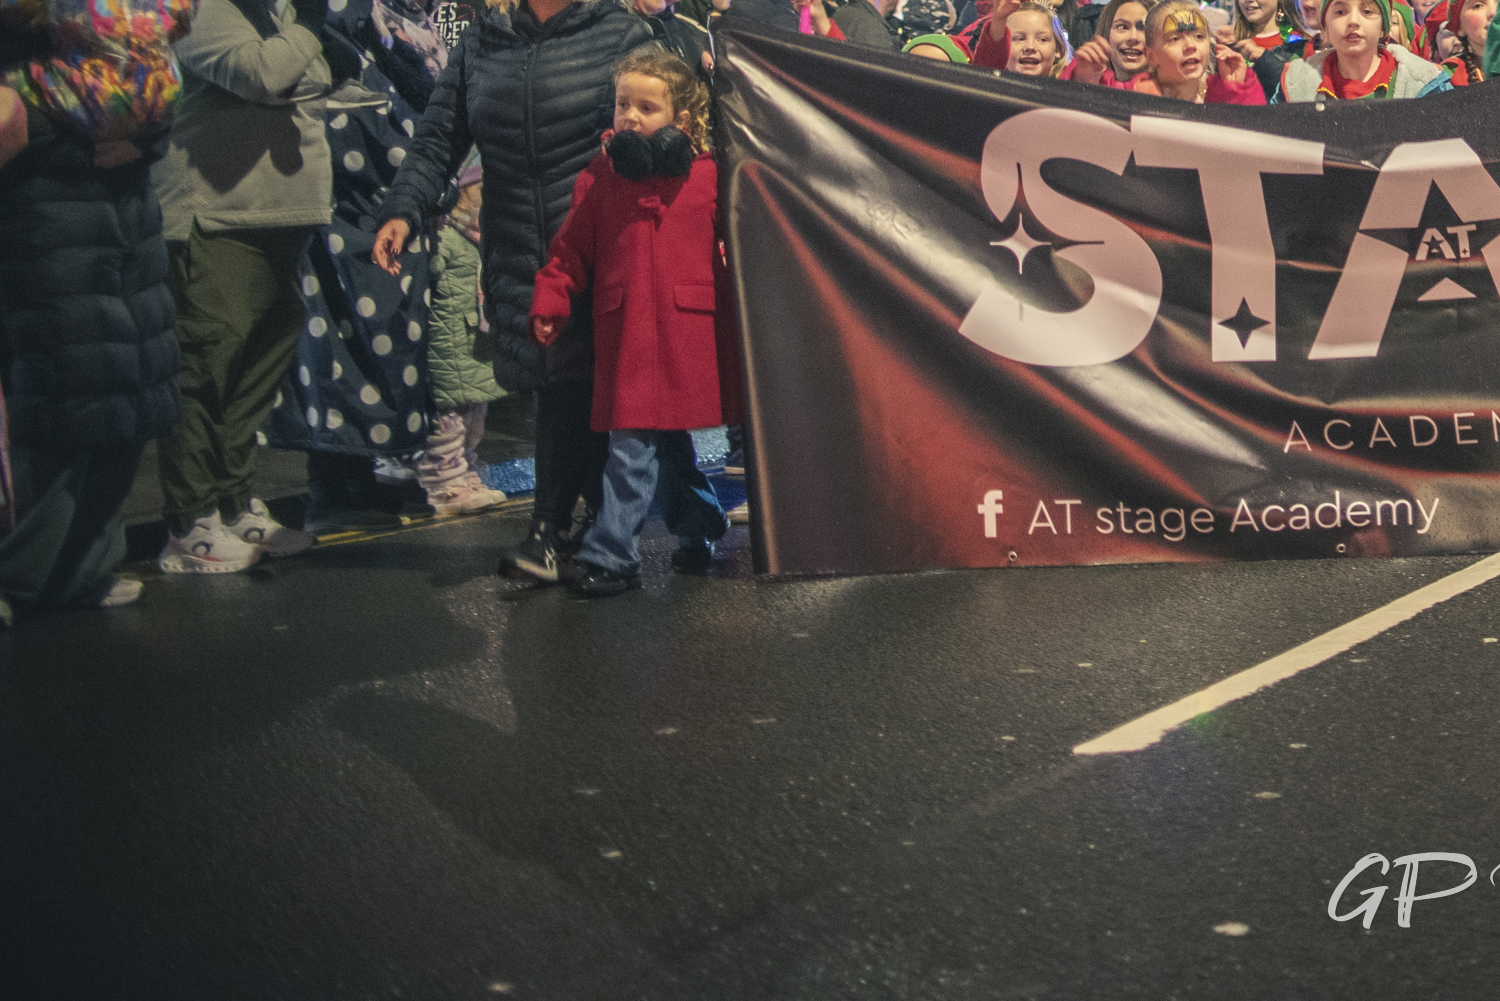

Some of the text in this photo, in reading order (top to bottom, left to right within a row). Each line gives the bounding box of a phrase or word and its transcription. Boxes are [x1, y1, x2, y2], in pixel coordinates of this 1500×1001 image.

[1415, 224, 1477, 261] AT
[1028, 499, 1083, 536] AT
[1095, 501, 1215, 542] stage
[1229, 489, 1441, 535] Academy
